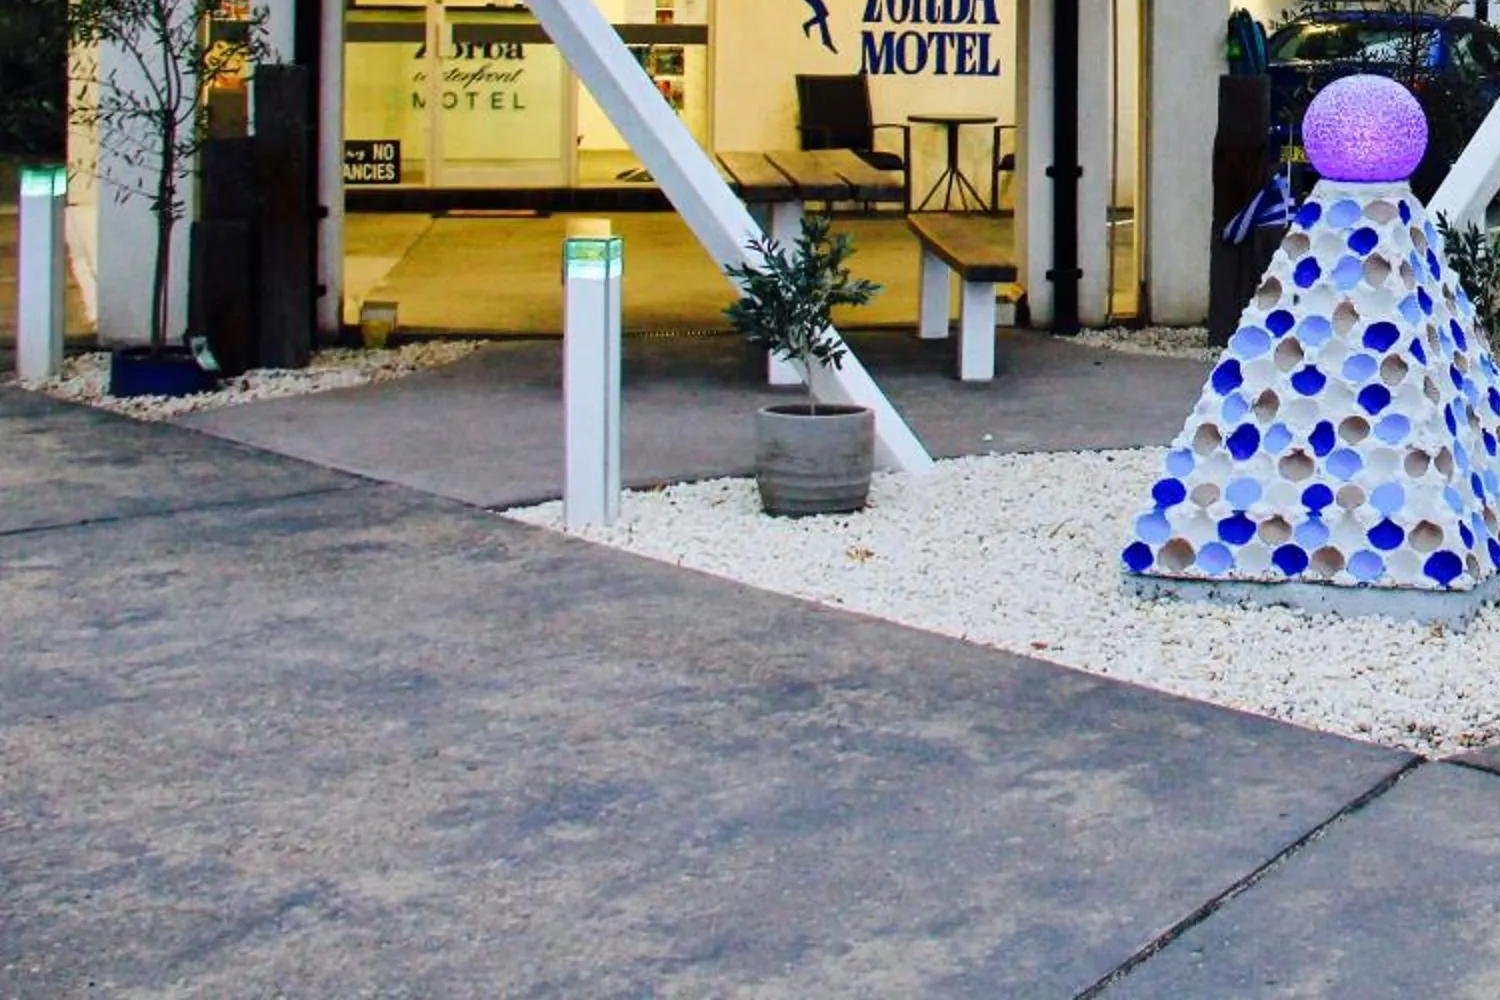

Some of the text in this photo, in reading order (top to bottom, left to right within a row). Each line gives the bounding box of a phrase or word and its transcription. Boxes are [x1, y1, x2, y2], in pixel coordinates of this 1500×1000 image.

[414, 42, 526, 60] rba
[861, 30, 1001, 76] MOTEL
[412, 62, 524, 88] terfront
[372, 143, 395, 161] NO
[343, 163, 395, 180] ANCIES
